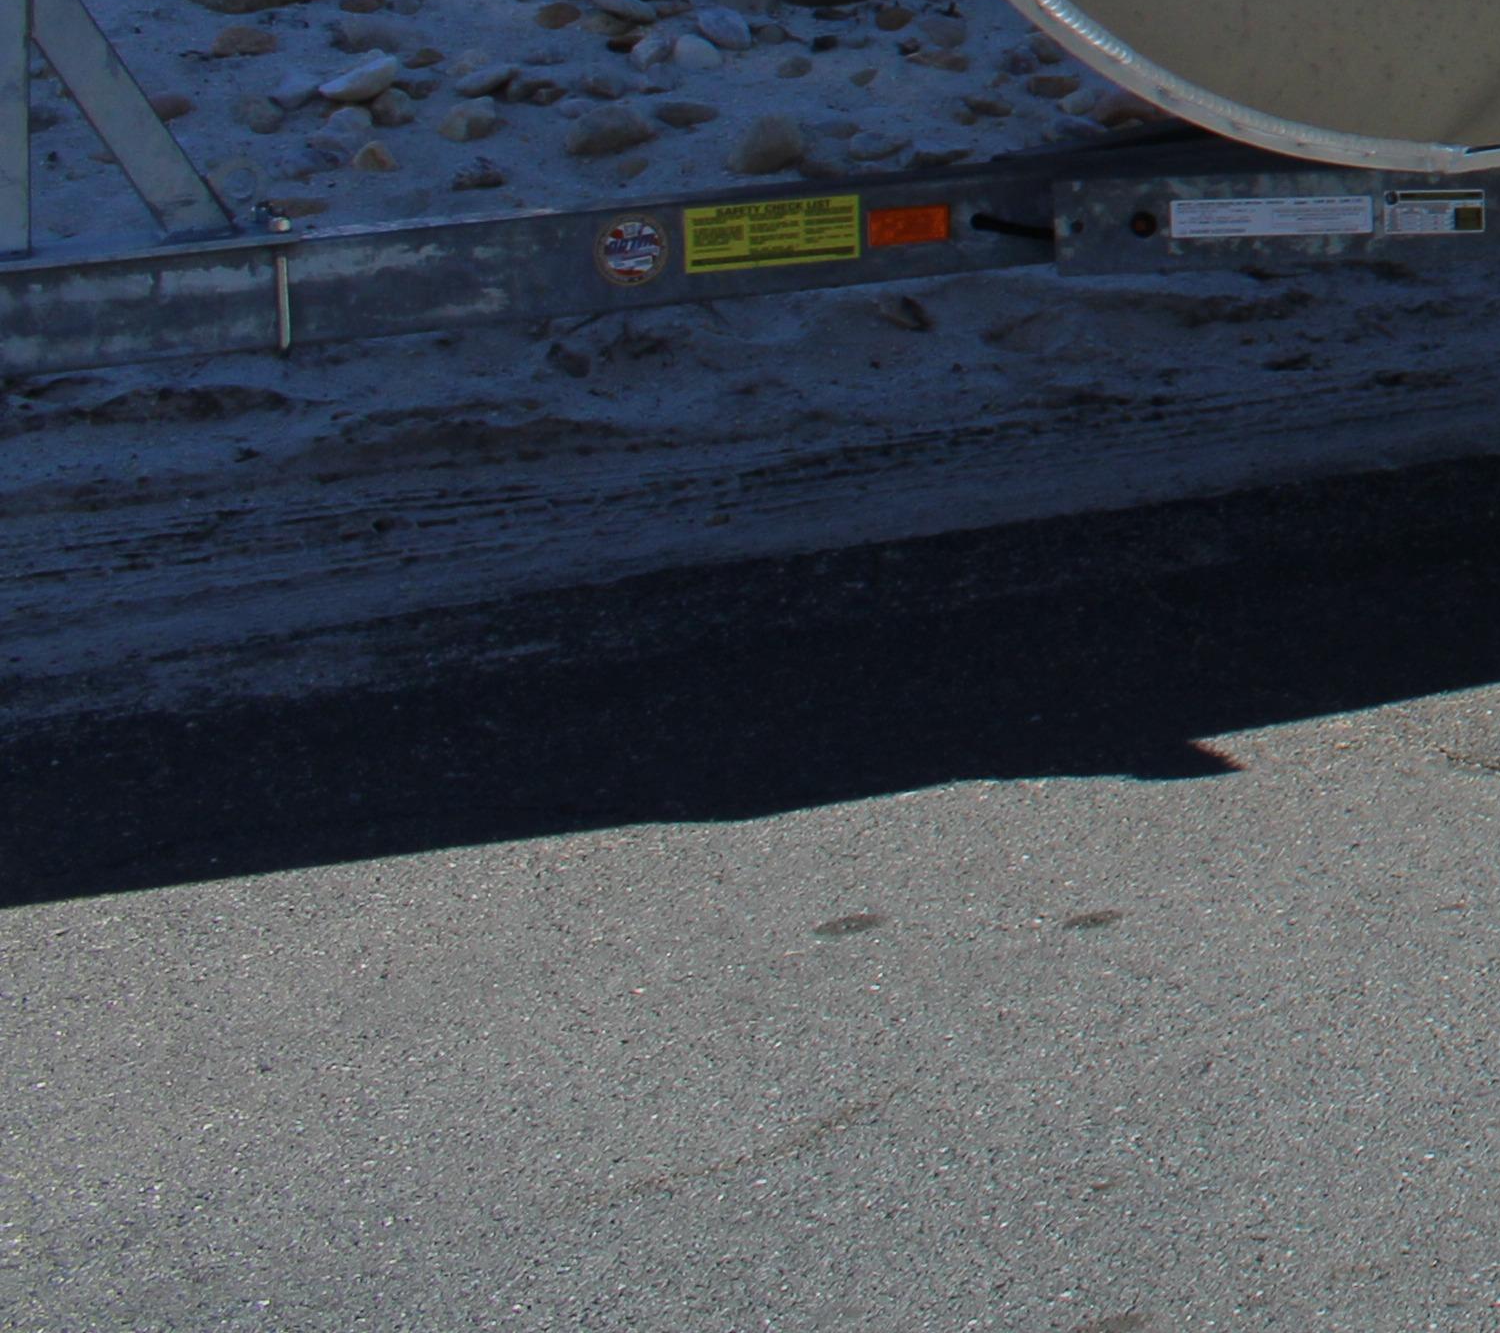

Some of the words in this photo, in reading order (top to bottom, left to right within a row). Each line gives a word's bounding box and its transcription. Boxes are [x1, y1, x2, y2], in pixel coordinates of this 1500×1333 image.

[716, 202, 760, 216] SAFETY
[764, 200, 802, 212] CHECK
[806, 198, 832, 209] LIST
